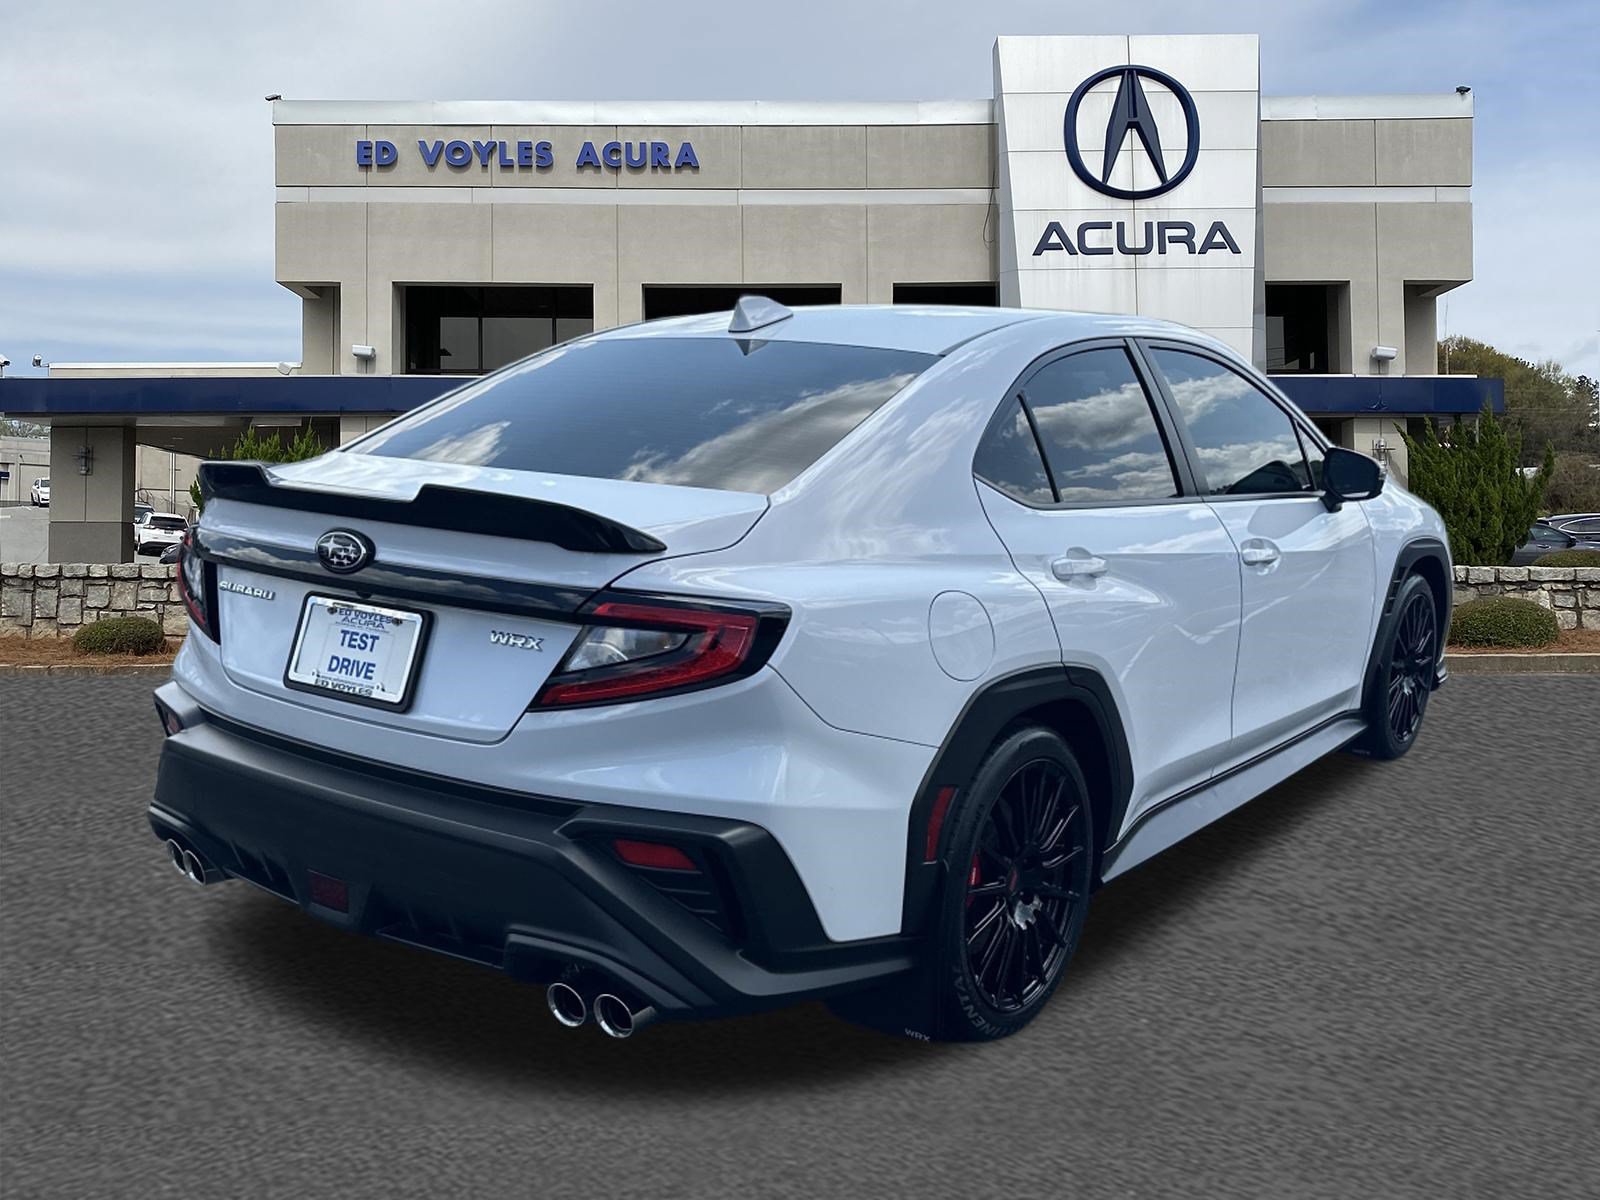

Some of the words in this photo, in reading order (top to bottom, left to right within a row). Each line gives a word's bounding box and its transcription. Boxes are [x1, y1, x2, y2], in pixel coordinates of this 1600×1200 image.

[356, 140, 398, 167] ED
[418, 140, 554, 168] VOYLES
[576, 141, 700, 168] ACURA
[1032, 221, 1242, 256] ACURA
[219, 580, 276, 601] SUBARU
[341, 616, 385, 629] ACURA
[340, 629, 380, 652] TEST
[491, 630, 544, 652] WRX
[327, 654, 376, 681] DRIVE
[331, 680, 373, 697] VOYLES
[904, 1027, 930, 1042] WRX
